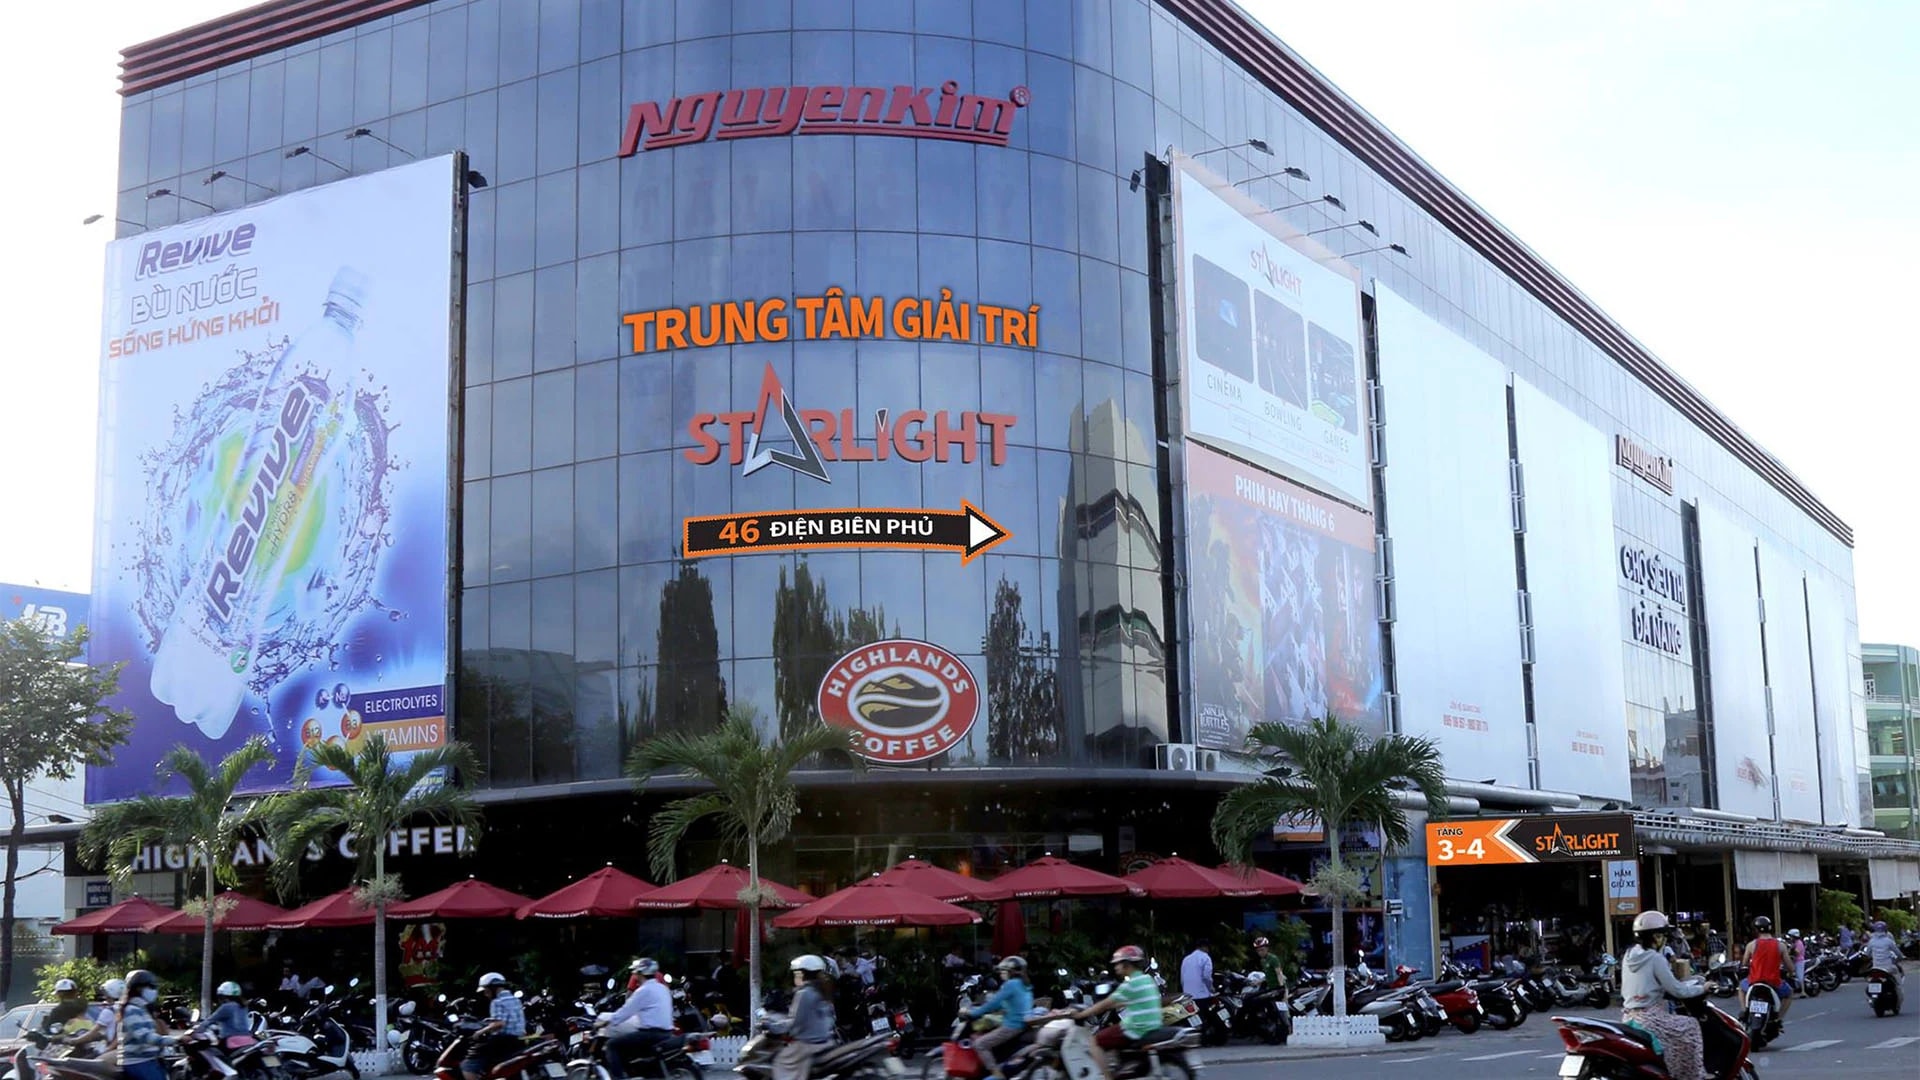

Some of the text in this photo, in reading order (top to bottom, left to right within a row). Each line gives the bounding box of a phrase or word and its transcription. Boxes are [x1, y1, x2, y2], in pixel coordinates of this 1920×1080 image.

[131, 264, 257, 324] BÙ NƯỚC
[109, 296, 280, 358] SỐNG HỨNG KHỞI
[623, 287, 1040, 353] TRUNG TÂM GIẢI TRÍ
[1207, 374, 1243, 402] CINEMA
[683, 361, 1017, 484] STARLIGHT
[1264, 401, 1302, 431] BOWLING
[1323, 429, 1350, 453] GAMES
[1235, 474, 1335, 532] PHIM HAY THÁNG 6
[719, 515, 934, 544] 46 ĐIỆN BIÊN PHỦ
[827, 647, 970, 698] HIGHLANDS
[365, 694, 437, 713] ELECTROLYTES
[1437, 838, 1486, 861] 3-4
[1535, 822, 1619, 857] STARLIGHT
[1625, 880, 1636, 888] XE
